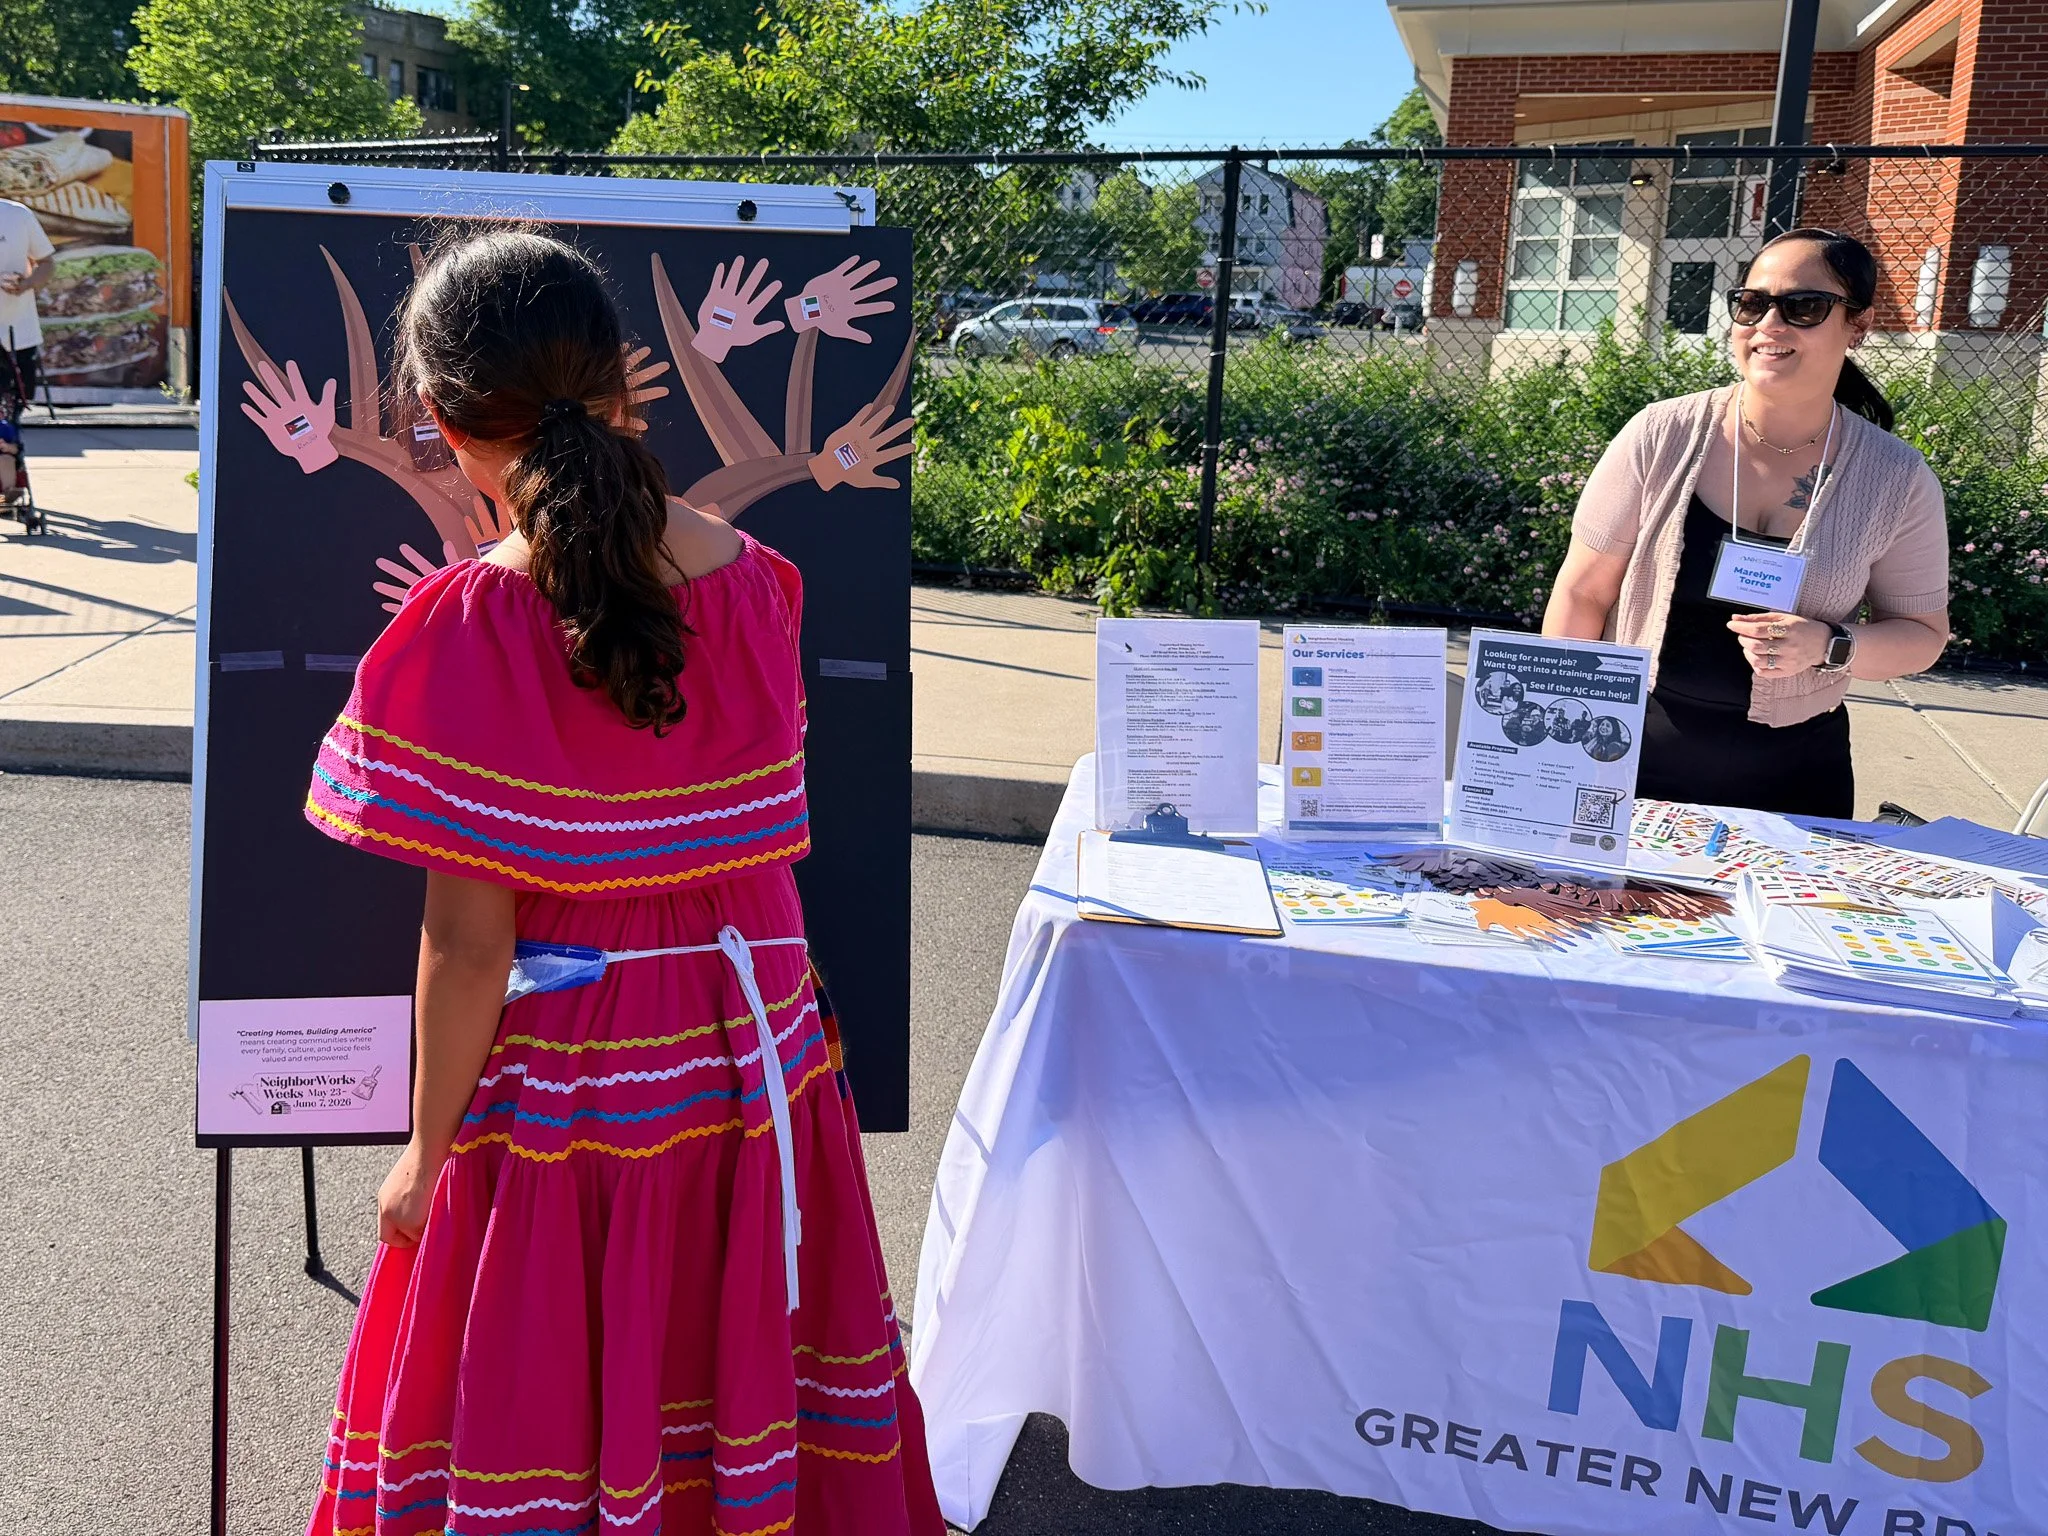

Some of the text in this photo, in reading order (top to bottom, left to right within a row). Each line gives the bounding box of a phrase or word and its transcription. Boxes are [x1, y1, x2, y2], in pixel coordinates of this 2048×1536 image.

[1734, 566, 1781, 582] Marelyne
[1740, 576, 1772, 588] Torres
[1292, 649, 1364, 658] Our Services
[1485, 650, 1517, 661] Looking
[1519, 653, 1531, 662] for
[1559, 658, 1577, 666] job?
[1483, 660, 1505, 669] Want
[1533, 666, 1550, 674] into
[1559, 670, 1592, 681] training
[1594, 673, 1635, 684] program?
[1530, 682, 1545, 690] See
[1548, 683, 1555, 691] if
[1556, 684, 1571, 693] the
[1573, 687, 1588, 695] AJC
[1608, 689, 1630, 700] help!
[306, 1027, 338, 1036] Building
[267, 1037, 297, 1045] creating
[262, 1046, 286, 1054] family,
[260, 1074, 355, 1089] NeighborWorks
[264, 1089, 303, 1099] Weeks
[308, 1088, 328, 1097] May
[293, 1100, 317, 1108] June
[328, 1098, 351, 1106] 2026
[1548, 1299, 1994, 1483] NHS
[1354, 1408, 1662, 1496] GREATER
[1685, 1466, 1859, 1532] NEW
